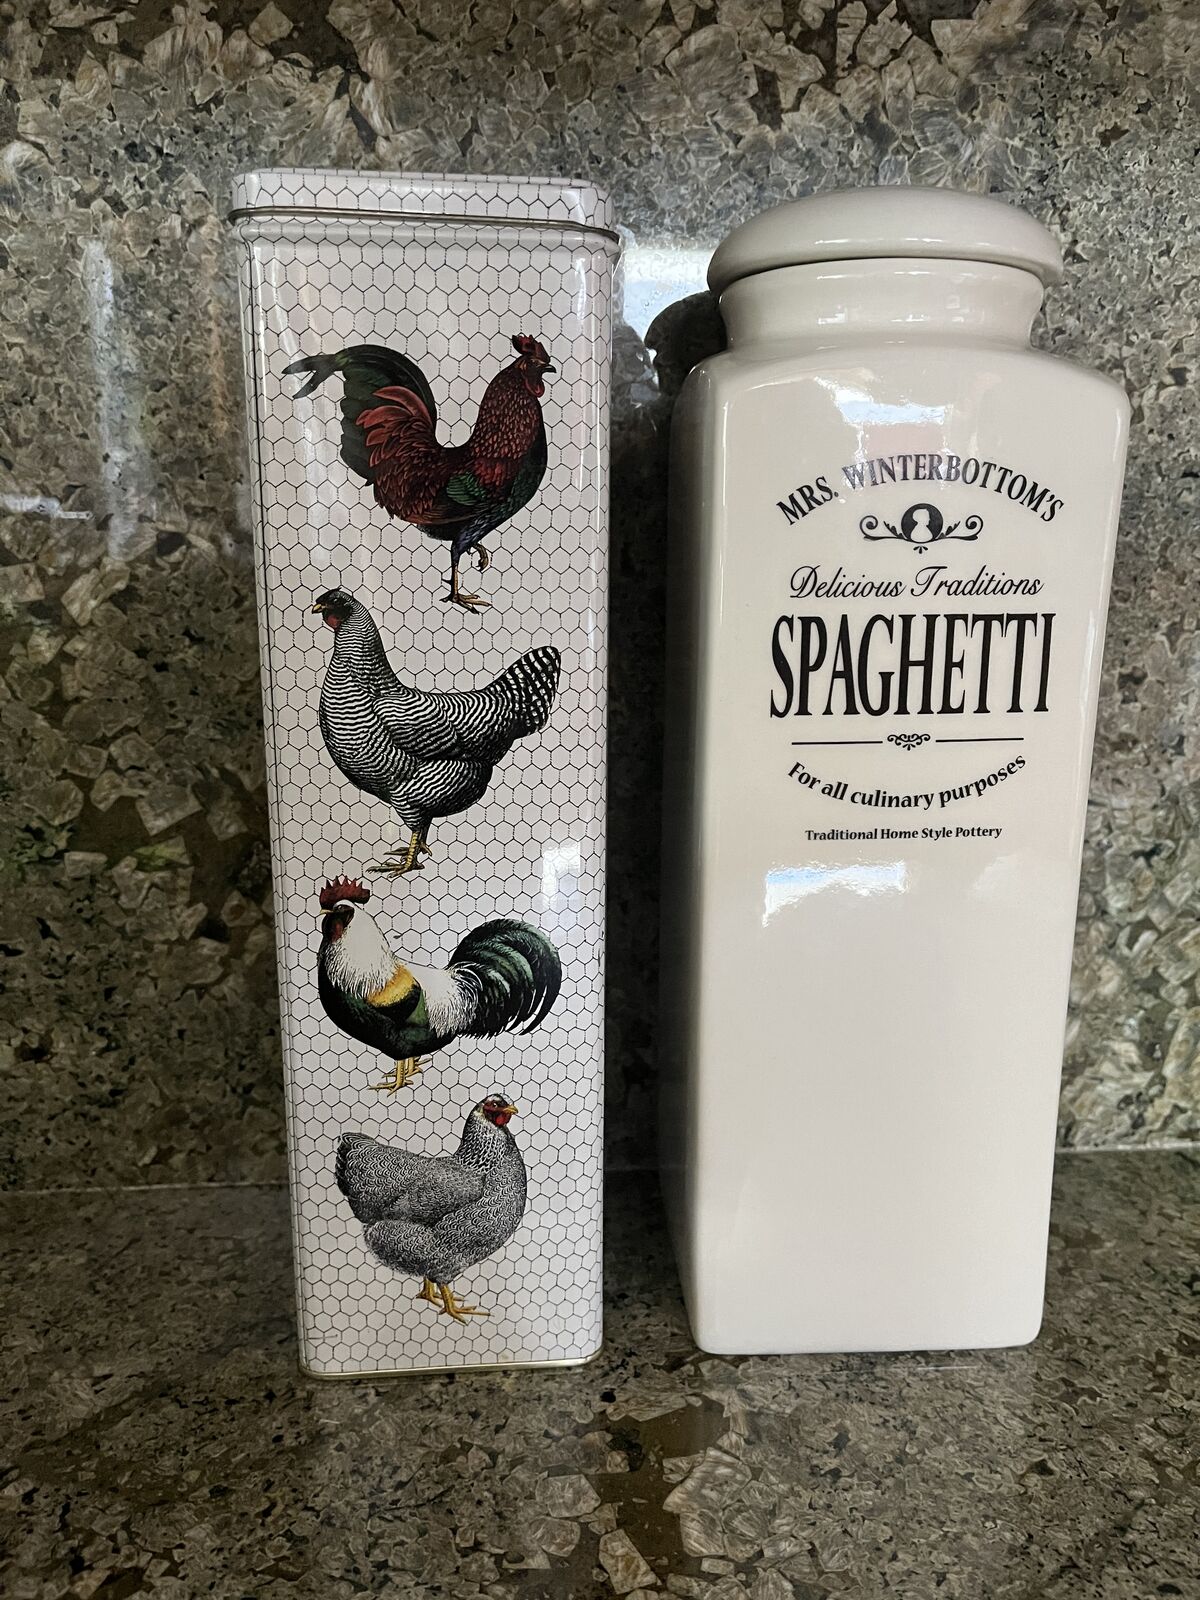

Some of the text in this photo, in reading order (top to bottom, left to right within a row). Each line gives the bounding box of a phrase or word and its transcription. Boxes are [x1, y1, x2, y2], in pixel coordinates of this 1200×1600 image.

[776, 453, 1064, 526] MRS. WINTERBOTTOM'S
[789, 564, 1045, 599] Delicious Traditions
[769, 612, 1057, 719] SPAGHETTI
[788, 754, 1026, 811] For all culinary purposes
[804, 826, 1003, 841] Traditional Home Style Pottery
